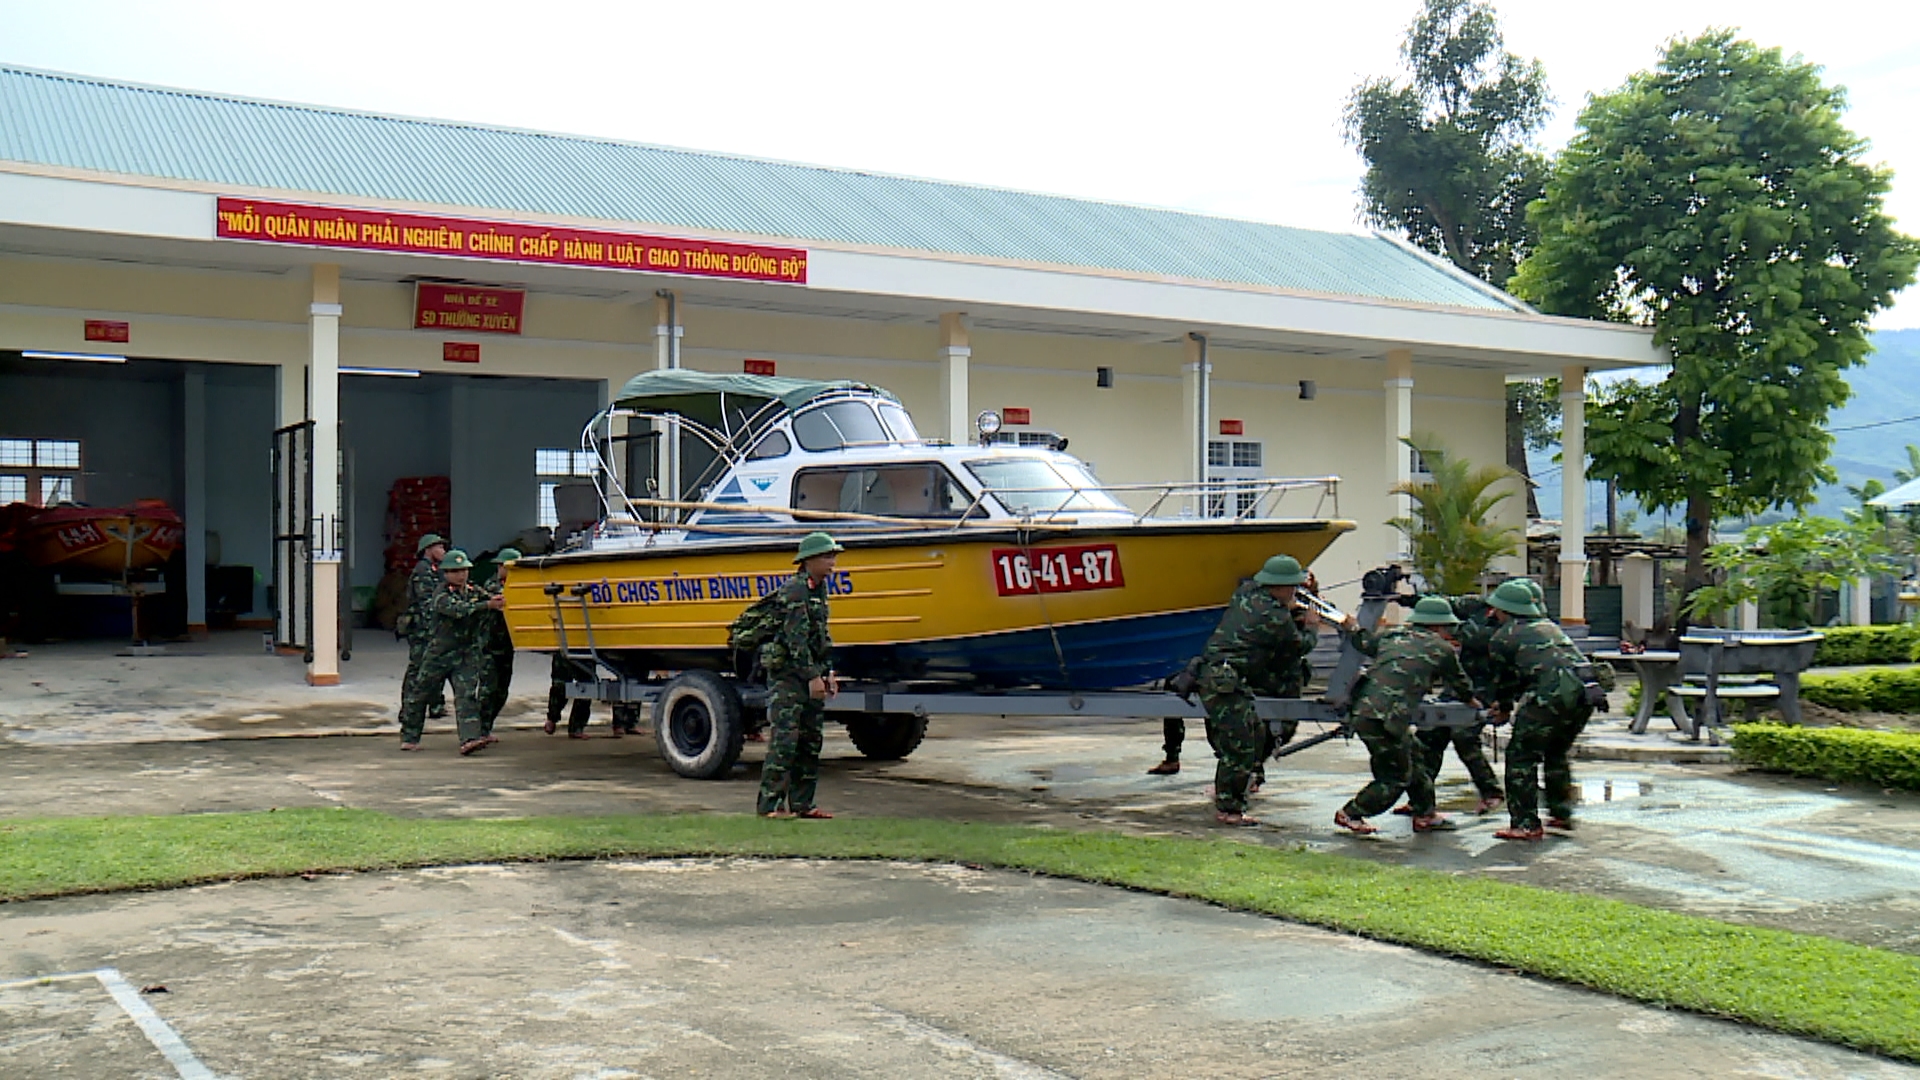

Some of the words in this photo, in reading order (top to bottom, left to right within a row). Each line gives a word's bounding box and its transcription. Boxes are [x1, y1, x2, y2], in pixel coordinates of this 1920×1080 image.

[265, 212, 309, 239] QUÂN
[313, 216, 357, 241] NHÂN
[362, 218, 399, 245] PHẢI
[403, 226, 462, 249] NGHIÊM
[469, 228, 514, 253] CHỈNH
[520, 232, 559, 257] CHẤP
[564, 238, 603, 261] HÀNH
[608, 242, 644, 267] LUẬT
[649, 248, 679, 267] GIAO
[684, 248, 729, 271] THÔNG
[732, 252, 777, 276] ĐƯỜNG
[483, 312, 517, 330] XUYÊN
[617, 580, 660, 606] CHQS
[663, 571, 703, 601] TỈNH
[708, 573, 751, 600] BÌNH
[998, 550, 1114, 590] 16-41-87
